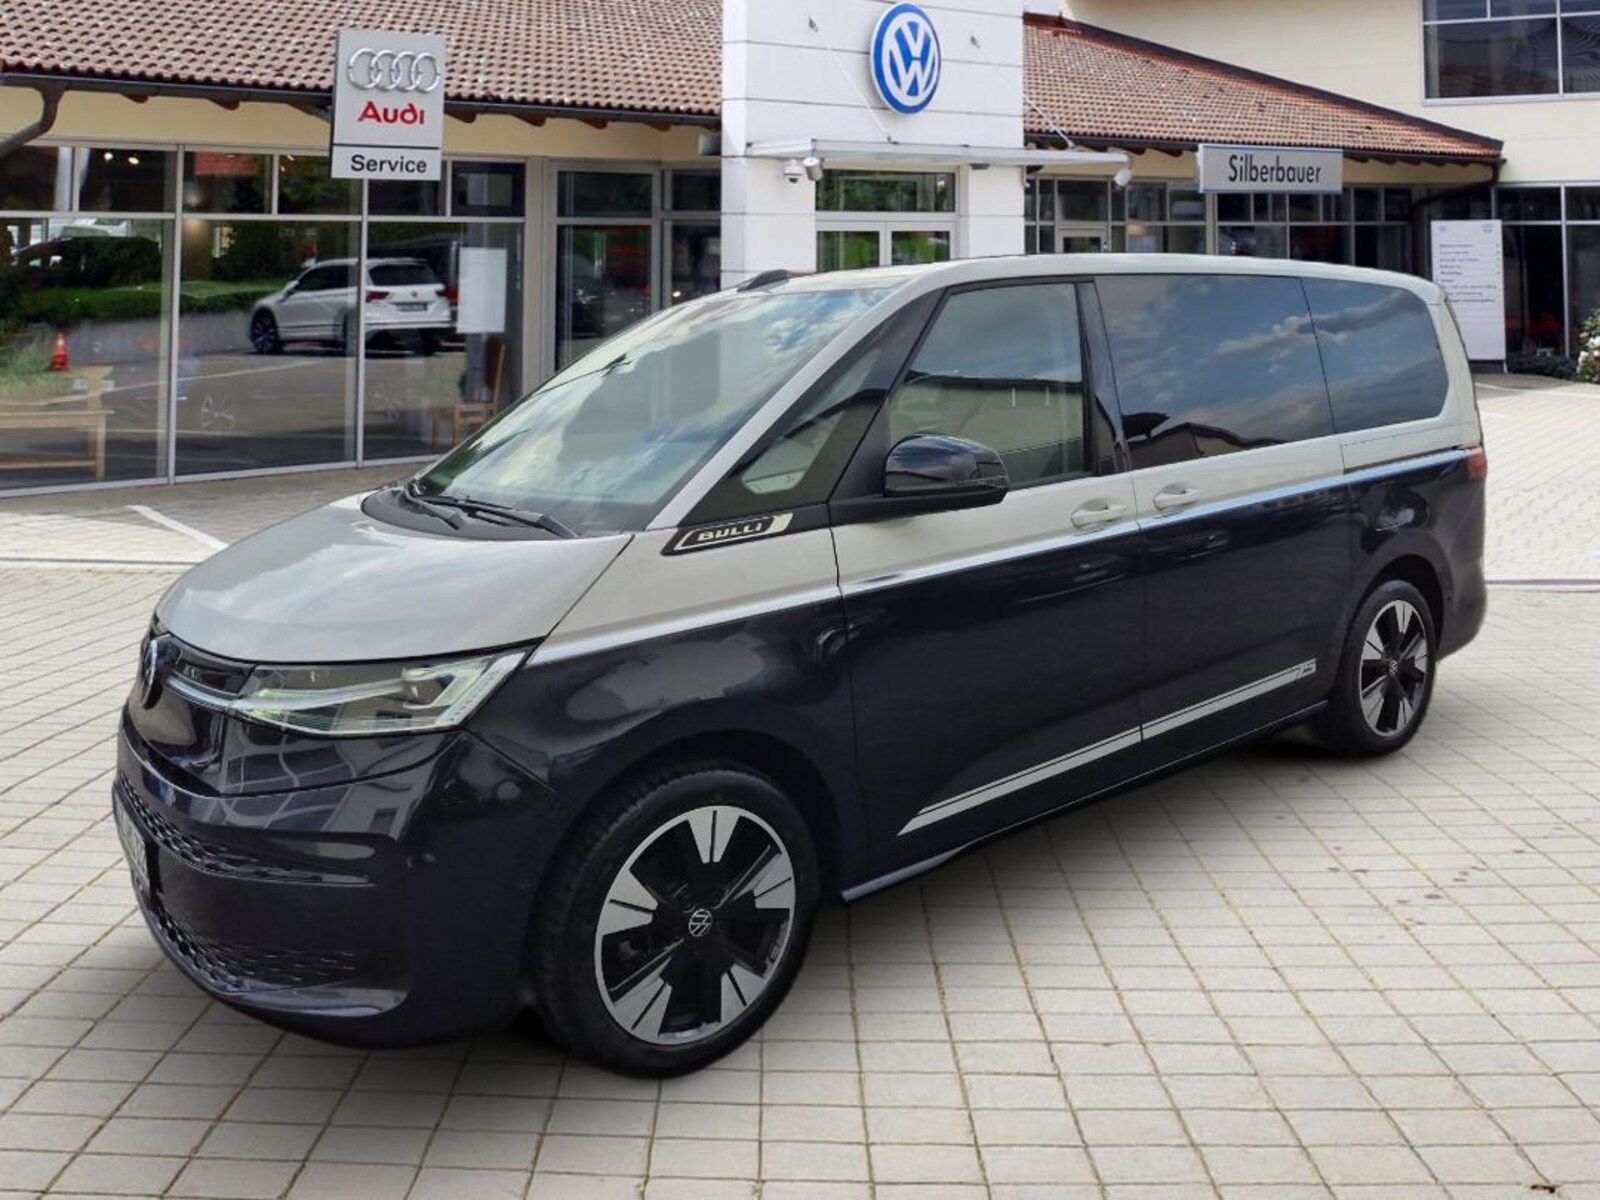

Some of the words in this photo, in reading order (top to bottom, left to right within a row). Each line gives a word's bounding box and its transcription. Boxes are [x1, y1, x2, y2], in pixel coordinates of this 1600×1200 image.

[357, 100, 425, 125] Audi
[350, 154, 428, 174] Service
[1228, 153, 1322, 184] Silberbauer
[697, 522, 763, 542] BULLI
